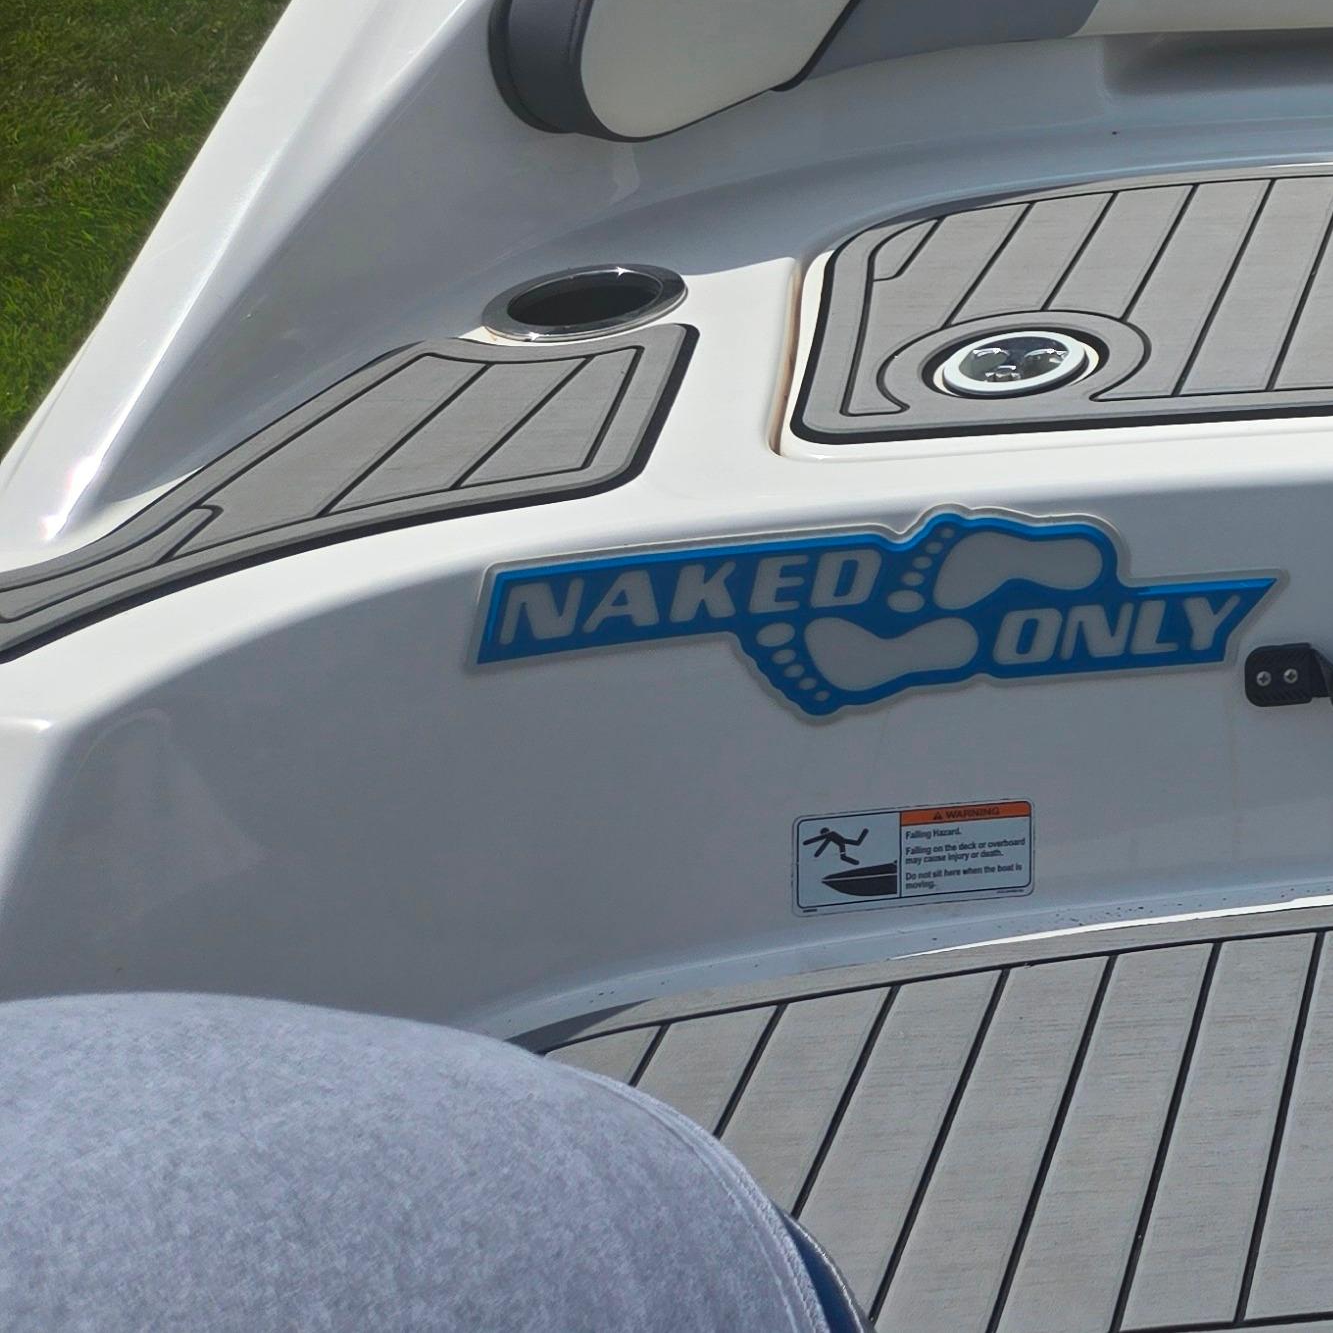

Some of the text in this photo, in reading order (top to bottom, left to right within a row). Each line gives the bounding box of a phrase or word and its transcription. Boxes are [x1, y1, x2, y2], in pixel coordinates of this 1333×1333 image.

[502, 547, 884, 646] NAKED
[992, 594, 1242, 666] ONLY
[946, 807, 1000, 819] WARNING
